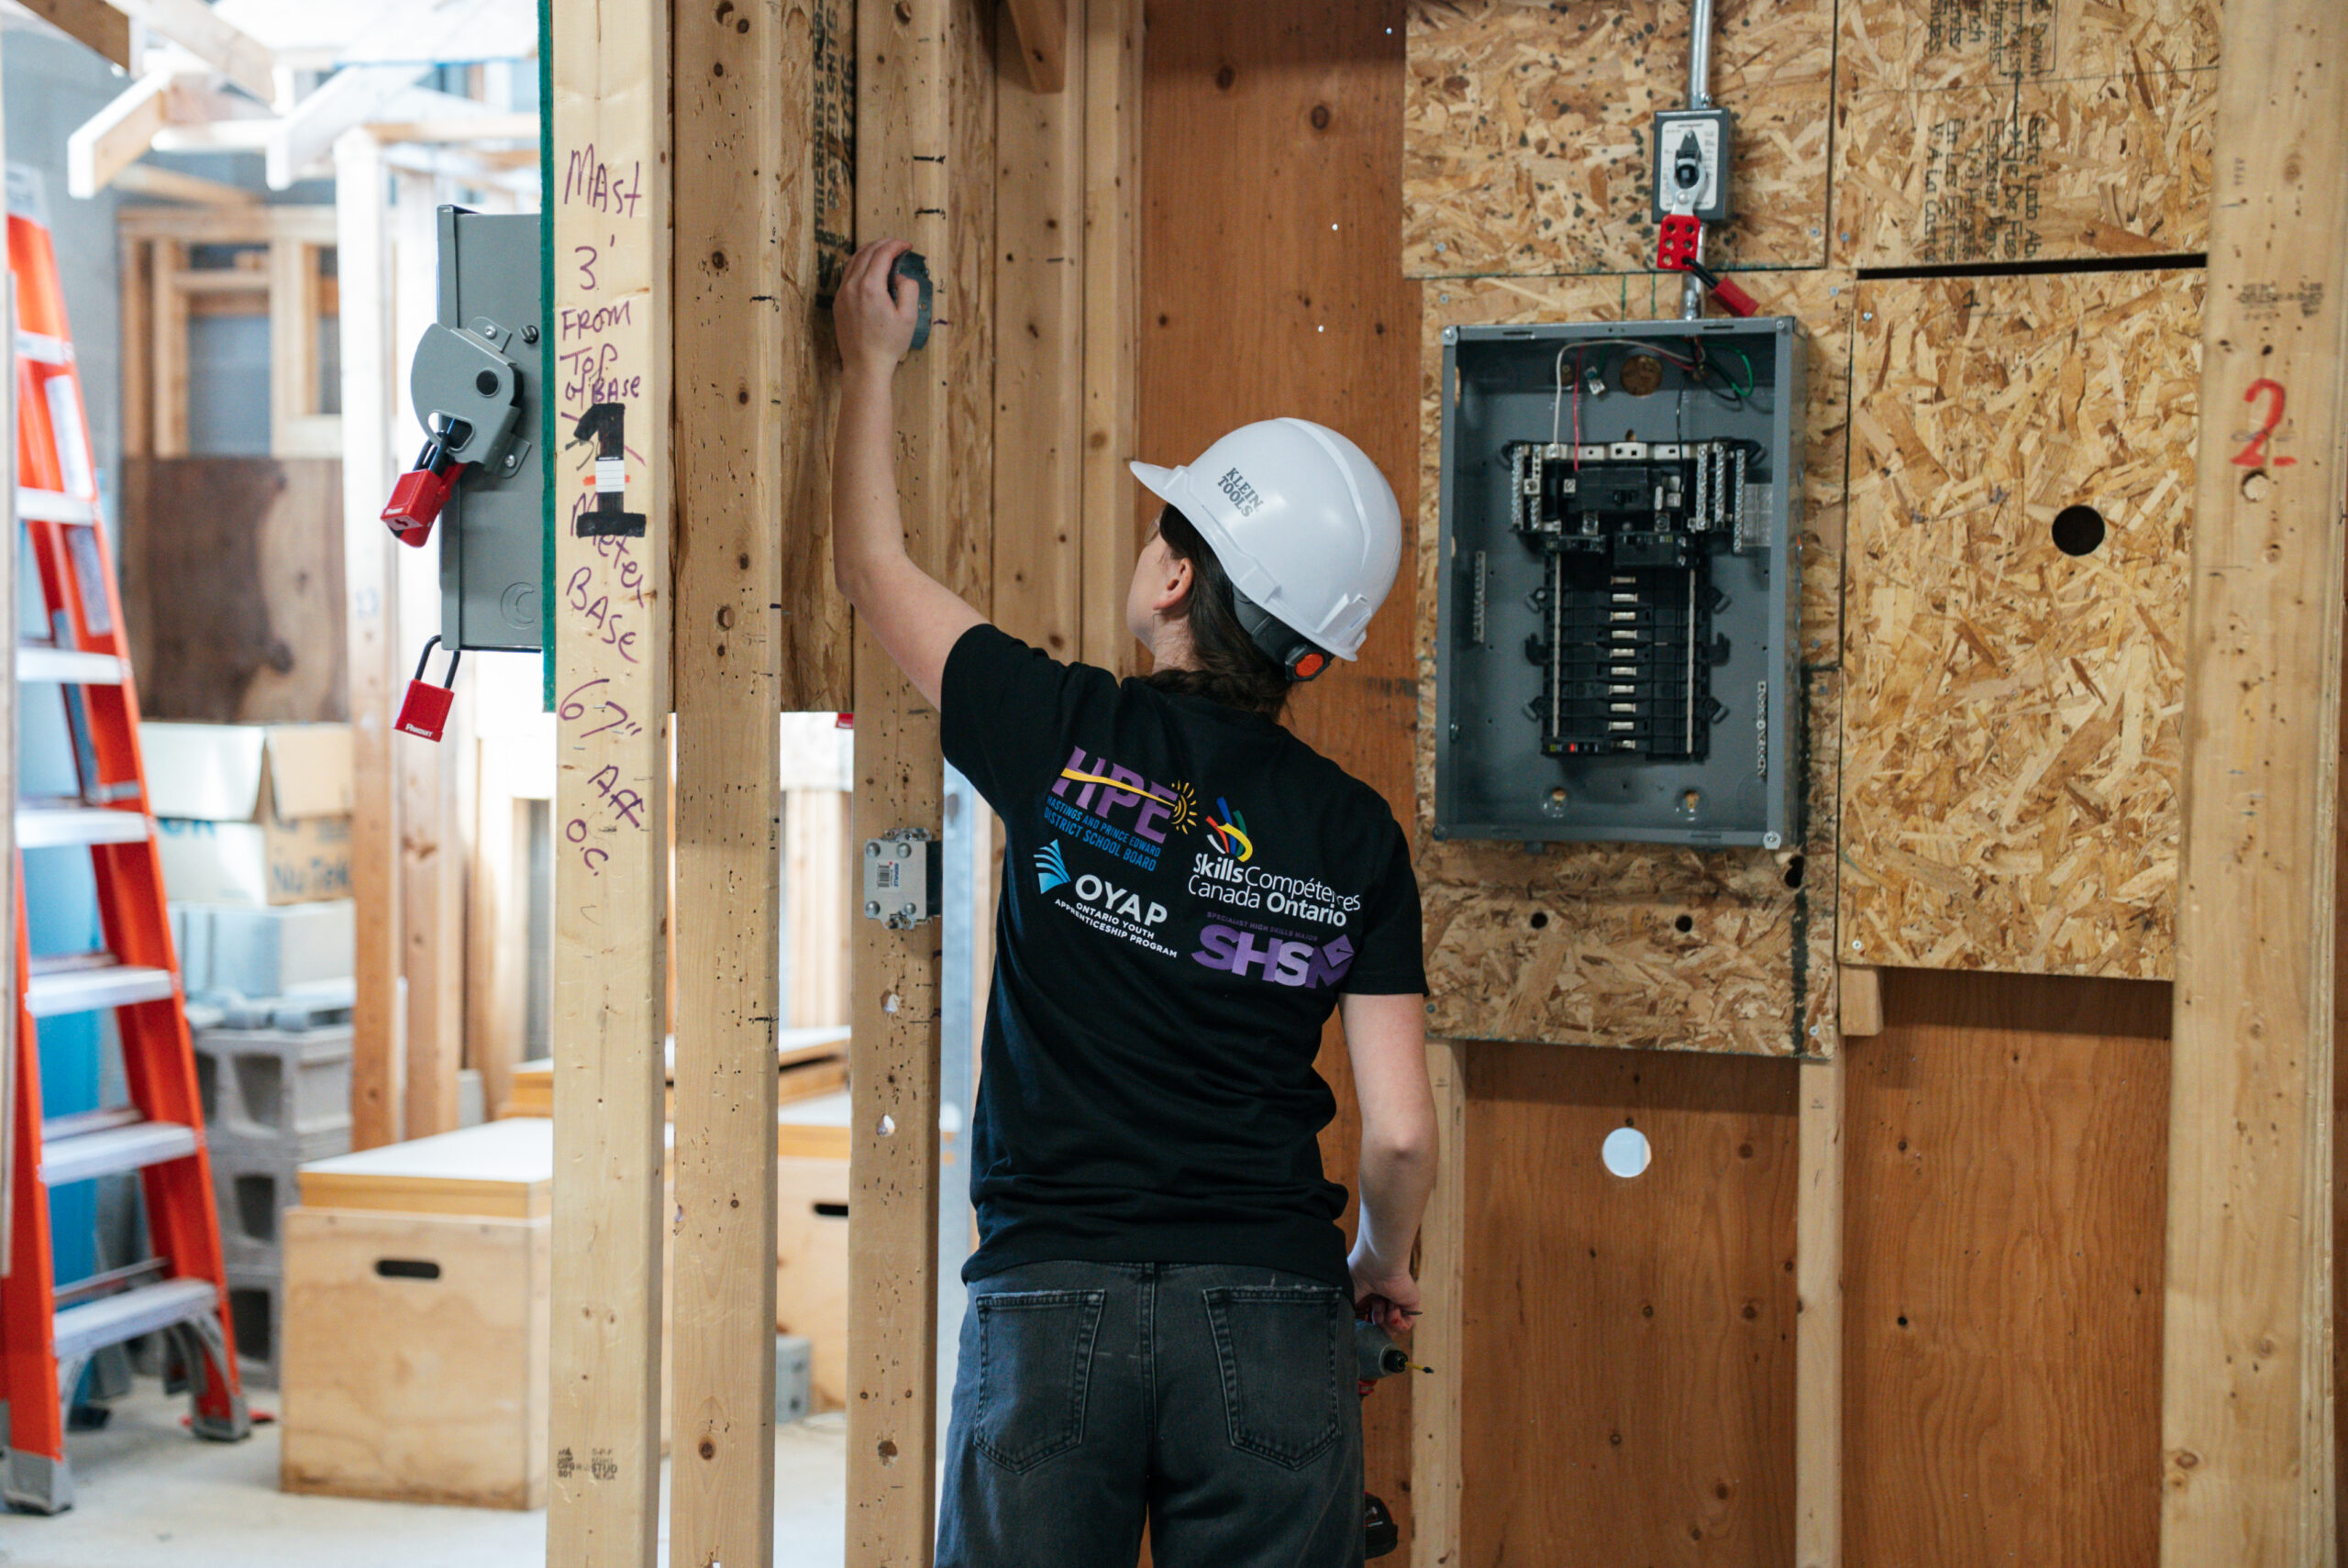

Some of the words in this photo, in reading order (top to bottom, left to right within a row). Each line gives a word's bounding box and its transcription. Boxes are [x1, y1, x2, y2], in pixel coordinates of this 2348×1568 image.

[2230, 378, 2298, 467] 2
[574, 403, 647, 538] 1
[1217, 475, 1254, 517] TOOLS
[1226, 467, 1264, 509] KLEIN
[1051, 745, 1180, 845] HPE
[1044, 807, 1083, 837] DISTRICT
[1082, 829, 1122, 857] SCHOOL
[1123, 847, 1157, 872] BOARD
[1046, 795, 1083, 822] HASTINGS
[1082, 815, 1101, 830] AND
[1100, 823, 1130, 844] PRINCE
[1128, 835, 1162, 857] EDWARD
[1055, 899, 1128, 938] APPRENTICESHIP
[1129, 934, 1178, 957] PROGRAM
[1075, 874, 1168, 927] OYAP
[1076, 902, 1120, 925] ONTARIO
[1122, 921, 1155, 940] YOUTH
[1189, 874, 1261, 909] Canada
[1267, 891, 1347, 927] Ontario
[1206, 911, 1248, 928] SPECIALIST
[1249, 922, 1269, 933] HIGH
[1269, 926, 1294, 937] SKILLS
[1294, 930, 1319, 942] MAJOR
